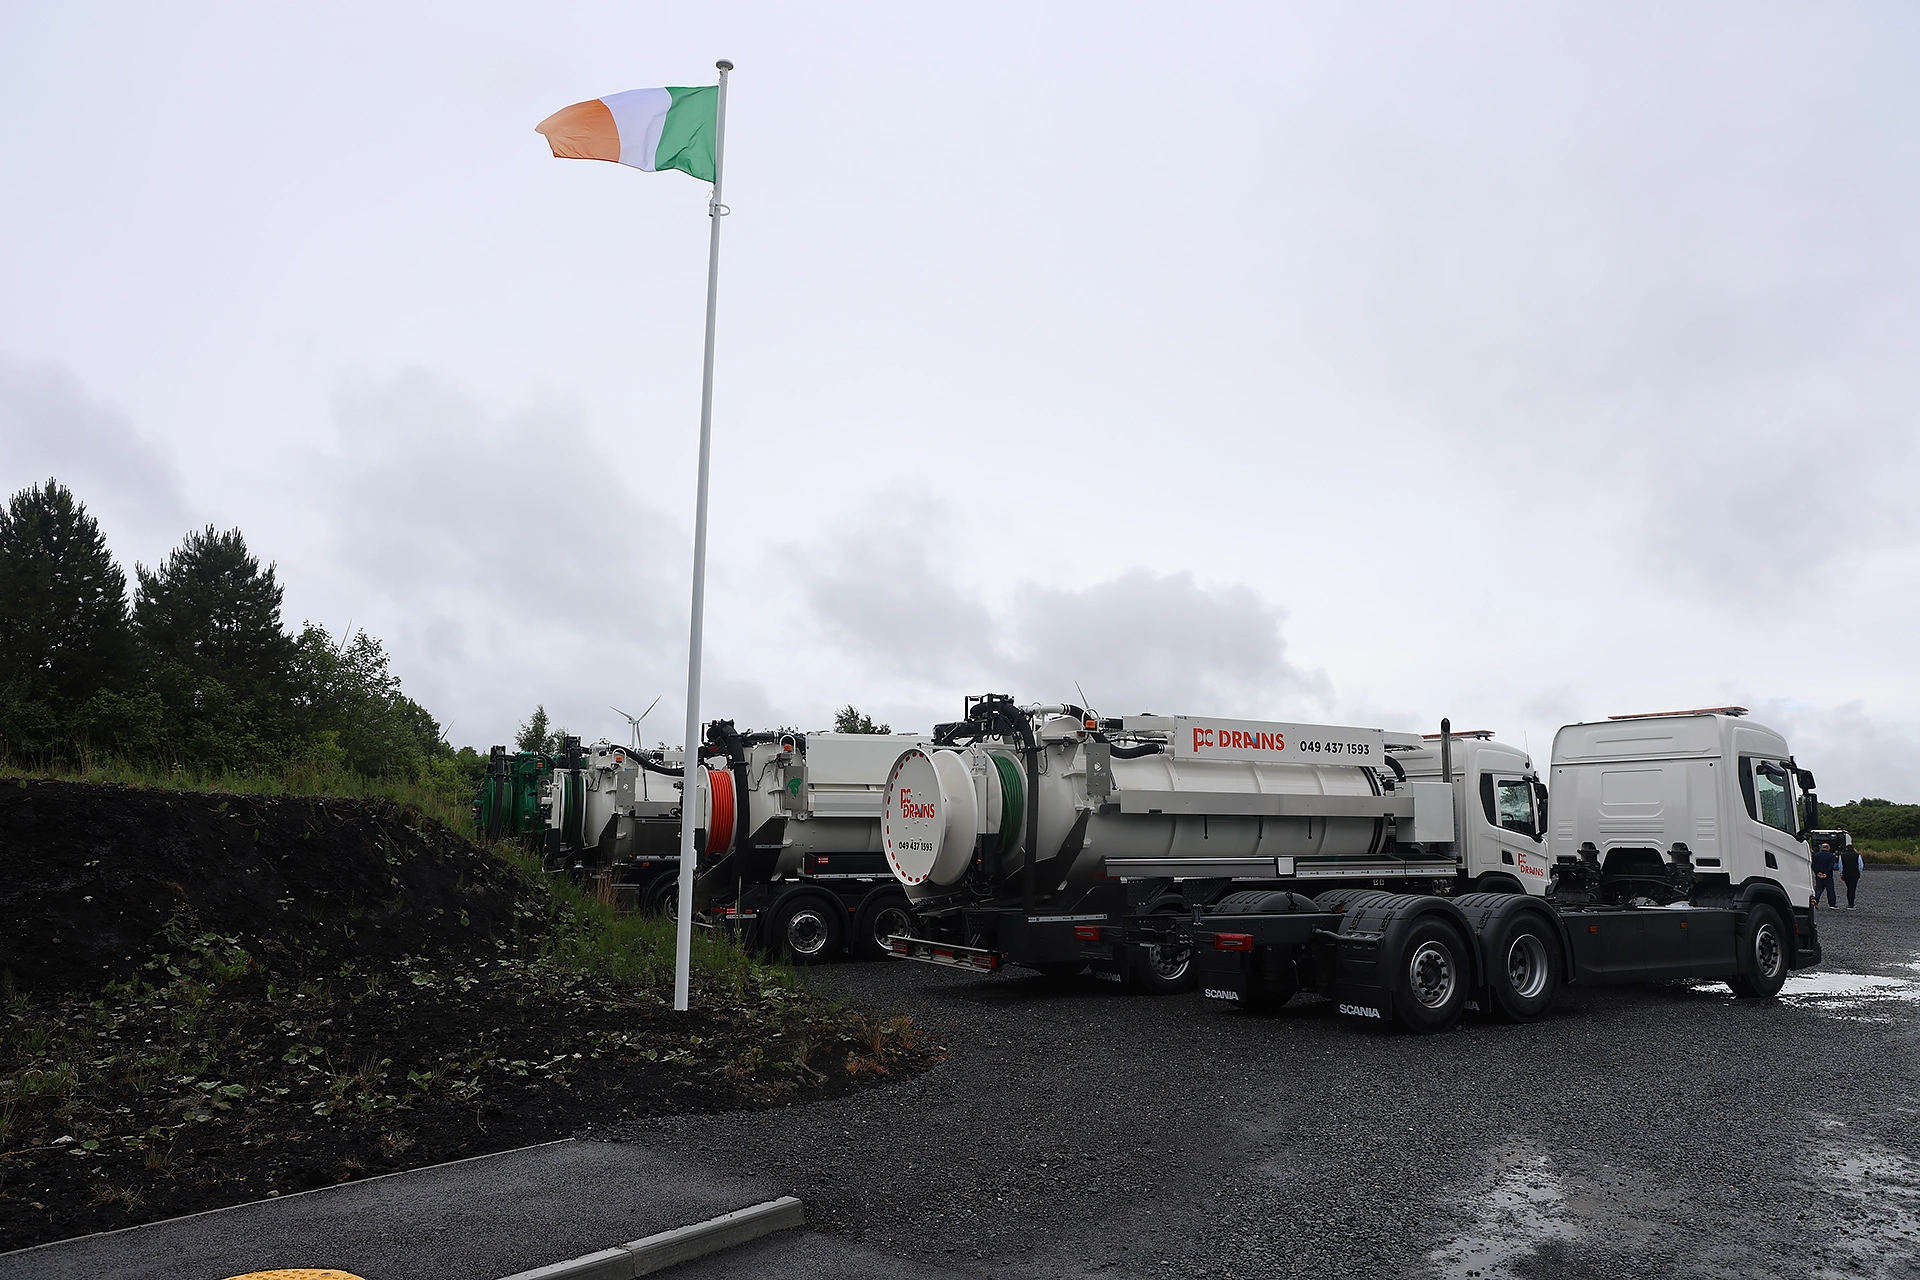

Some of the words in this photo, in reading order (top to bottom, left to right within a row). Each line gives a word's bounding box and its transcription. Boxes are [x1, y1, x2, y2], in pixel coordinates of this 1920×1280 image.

[1219, 729, 1285, 751] DRAINS
[1299, 740, 1321, 753] 049
[1324, 742, 1343, 754] 437
[1346, 743, 1370, 755] 1593
[903, 803, 935, 818] DRAINS
[898, 841, 909, 850] 049
[910, 842, 920, 851] 437
[920, 842, 932, 851] 1593
[1520, 865, 1544, 876] DRAINS
[1095, 971, 1122, 983] SCANIA
[1204, 988, 1239, 1000] SCANIA
[1339, 1004, 1381, 1018] SCANIA
